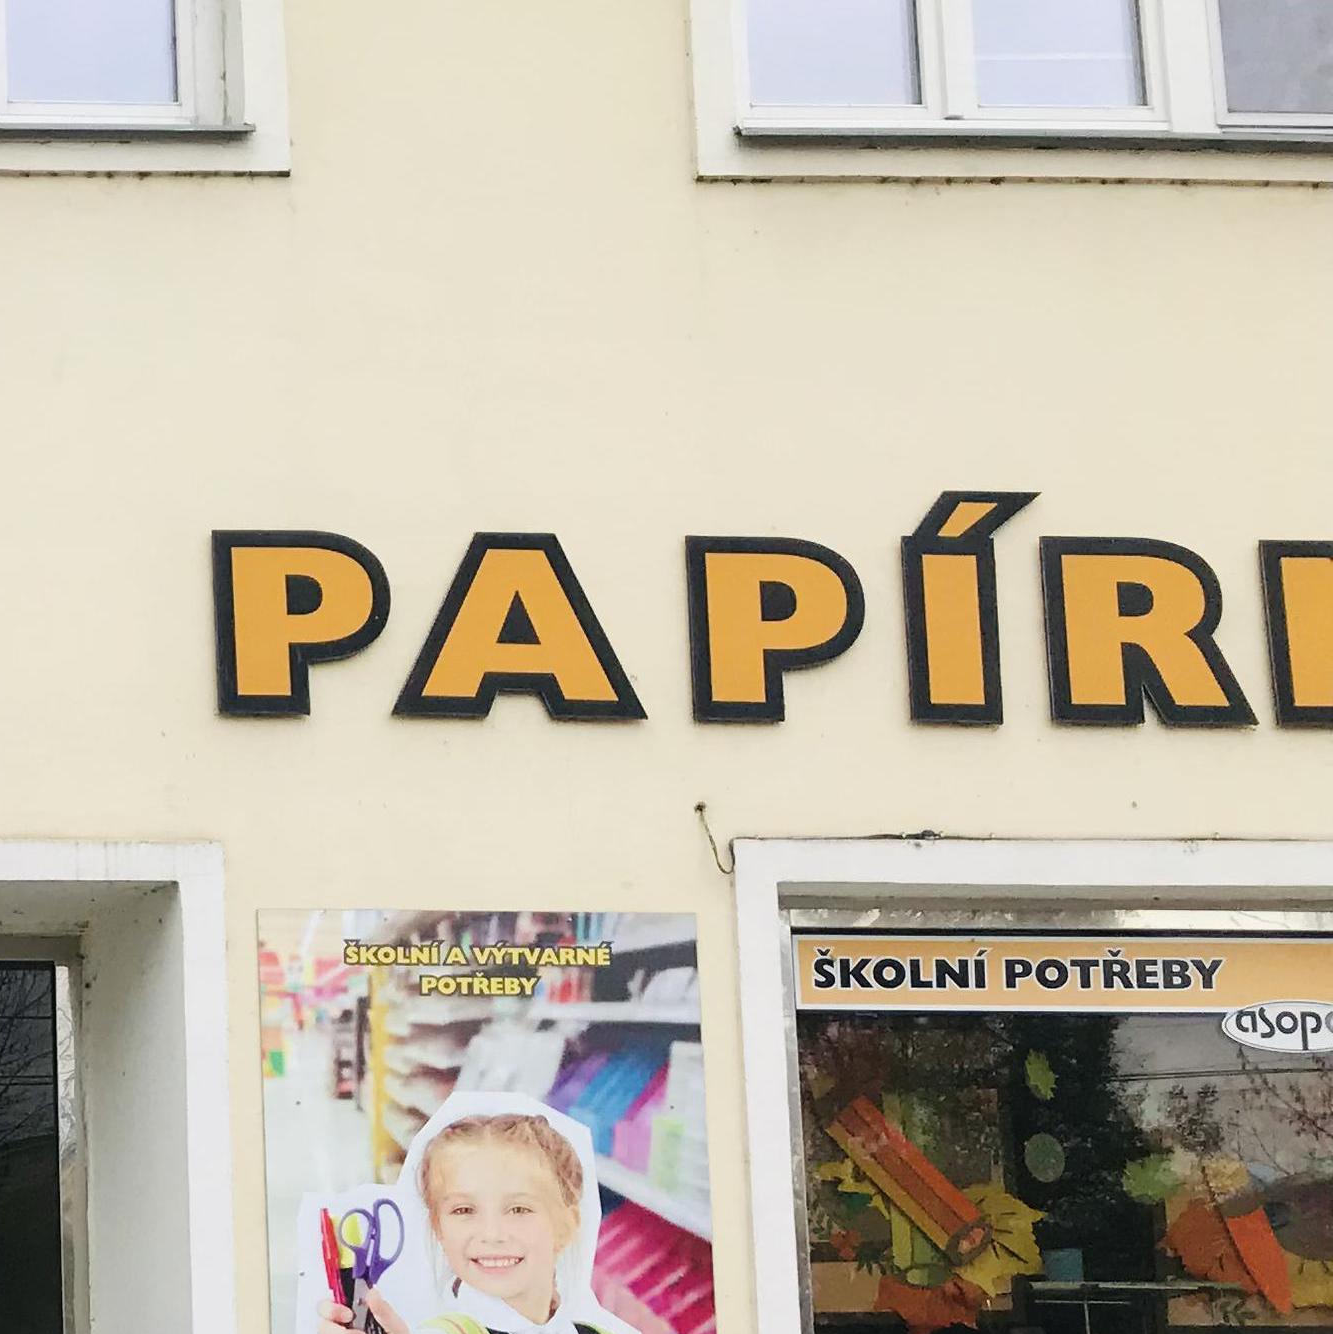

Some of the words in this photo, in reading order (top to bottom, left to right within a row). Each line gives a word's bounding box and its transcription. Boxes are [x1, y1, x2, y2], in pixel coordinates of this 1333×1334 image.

[344, 939, 444, 966] ŠKOLNÍ
[443, 945, 469, 966] A
[471, 940, 615, 966] VÝTVARNÉ
[813, 947, 991, 989] ŠKOLNÍ
[1003, 948, 1223, 990] POTŘEBY
[419, 970, 541, 996] POTŘEBY
